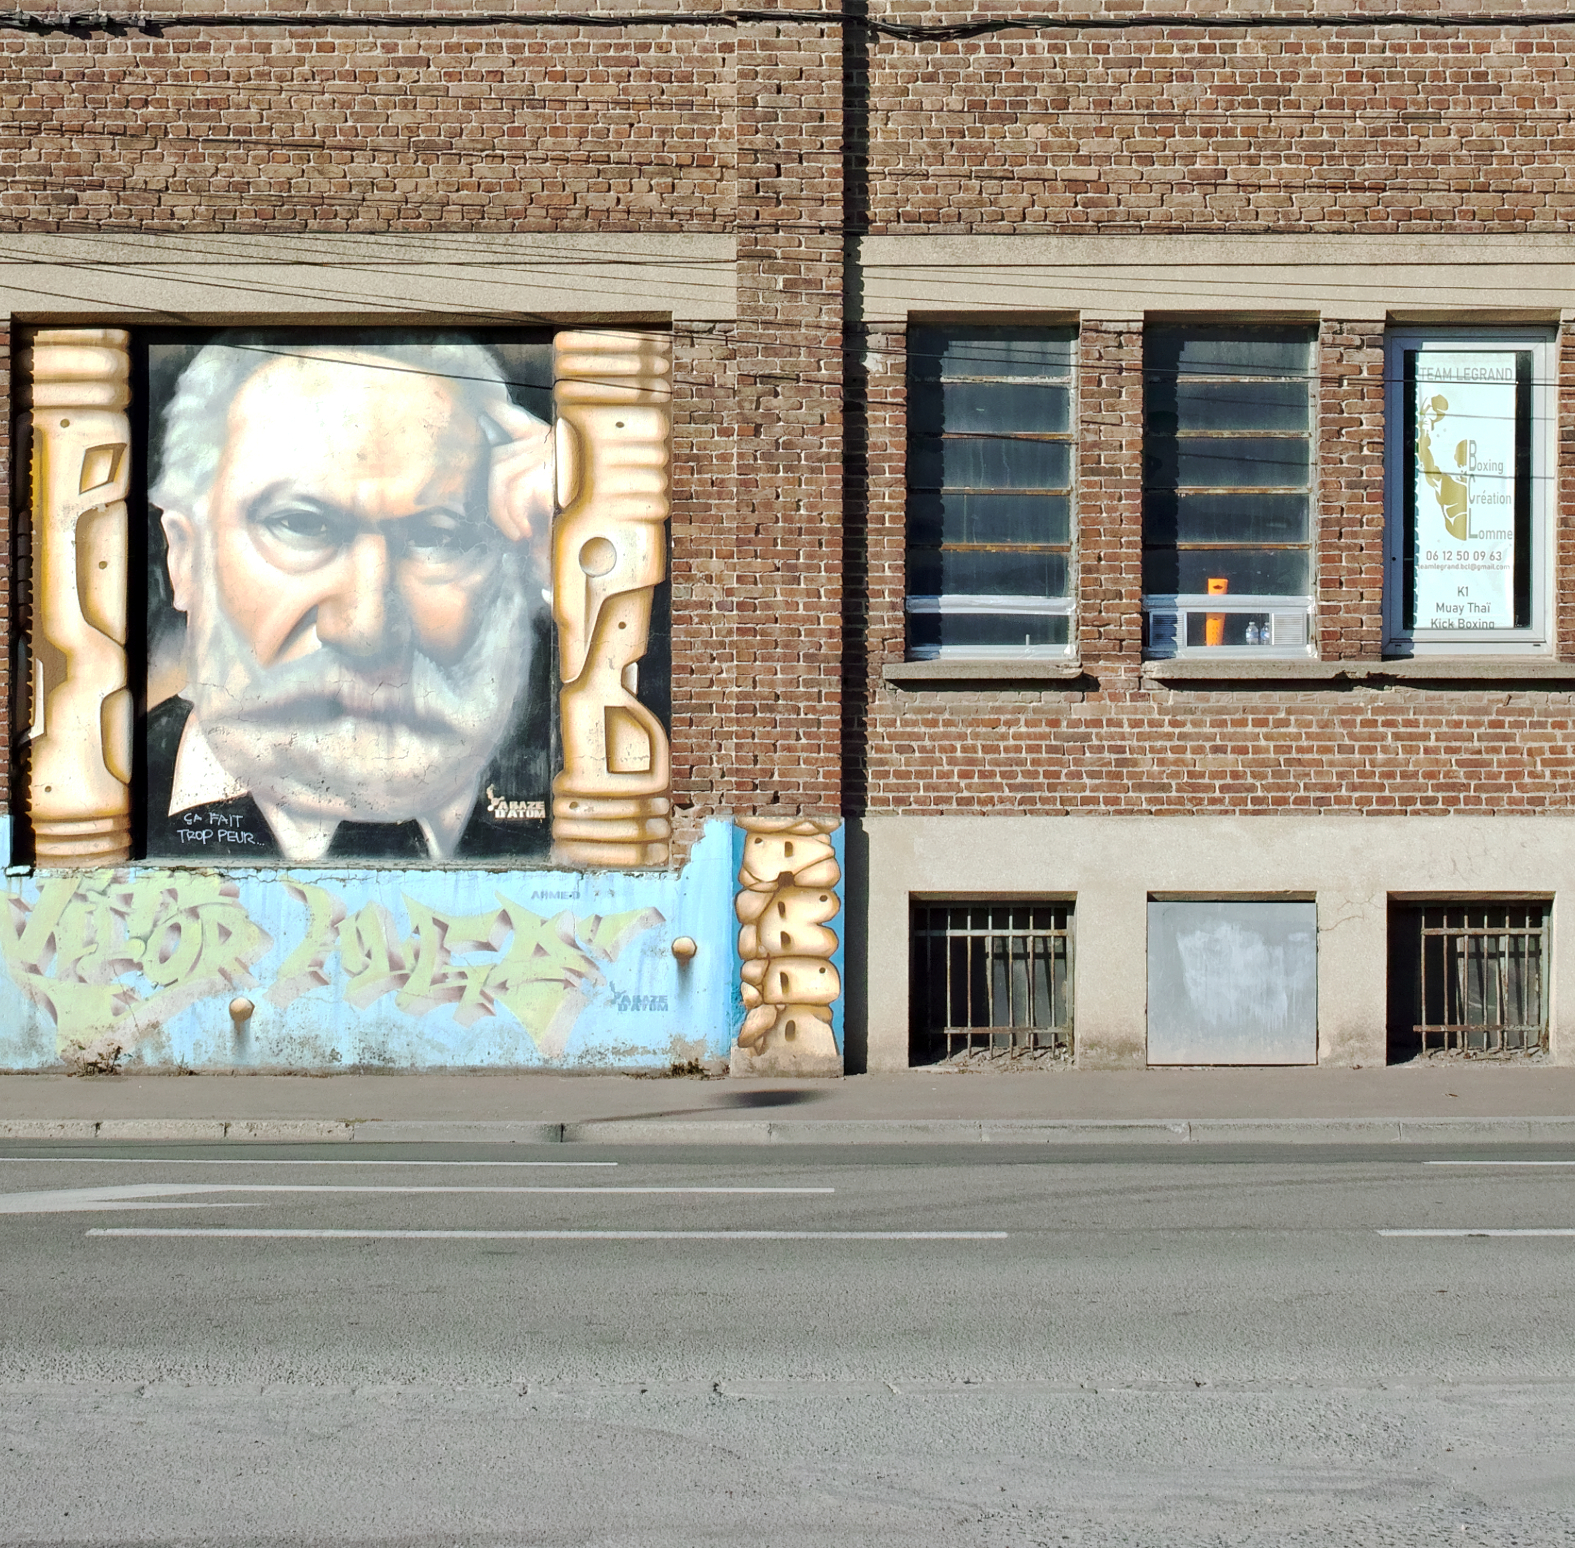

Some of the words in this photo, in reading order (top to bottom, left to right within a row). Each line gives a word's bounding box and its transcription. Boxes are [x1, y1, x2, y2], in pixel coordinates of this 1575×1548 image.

[1420, 367, 1452, 381] TEAM
[1456, 367, 1513, 381] LEGRAND
[1468, 439, 1504, 474] Boxing
[1468, 473, 1512, 505] Création
[1468, 507, 1513, 540] Lomme
[1426, 550, 1439, 561] 06
[1442, 550, 1453, 561] 12
[1456, 550, 1470, 561] 50
[1473, 551, 1486, 561] 09
[1489, 551, 1502, 561] 63
[1457, 586, 1469, 597] K1
[1435, 602, 1464, 615] Muay
[1467, 602, 1491, 613] Thaï
[1430, 618, 1454, 629] Kick
[209, 812, 244, 828] FAIT
[176, 829, 214, 845] TROP
